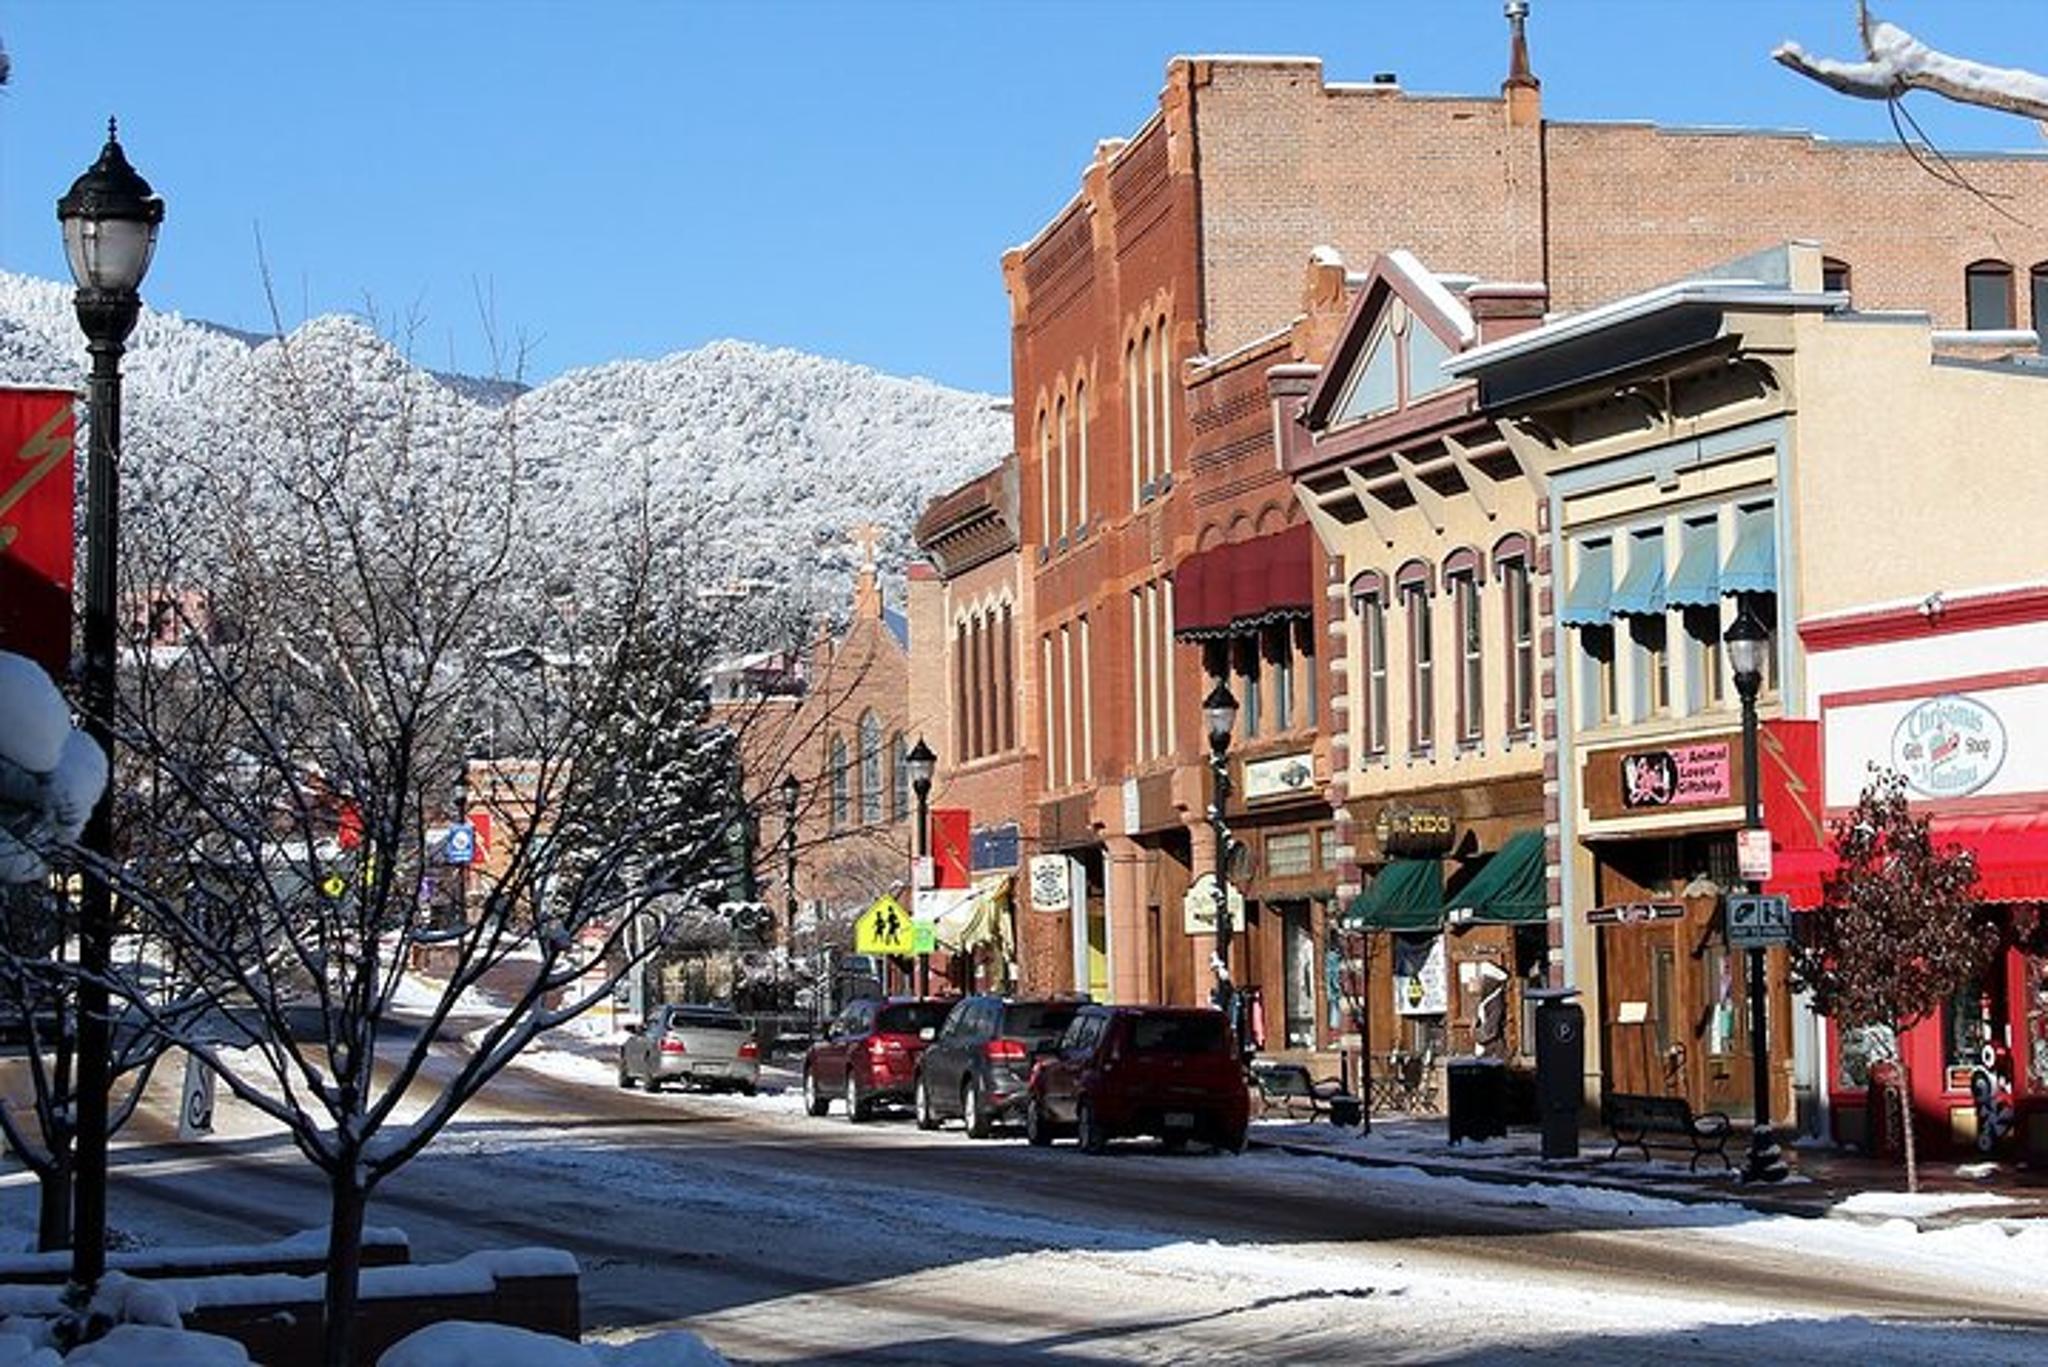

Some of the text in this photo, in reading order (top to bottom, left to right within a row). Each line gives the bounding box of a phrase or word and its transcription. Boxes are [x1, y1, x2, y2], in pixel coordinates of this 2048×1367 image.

[1907, 702, 1984, 740] Christmas
[1689, 746, 1726, 763] Animal
[1965, 737, 1991, 760] Shop
[1409, 815, 1451, 833] KEG
